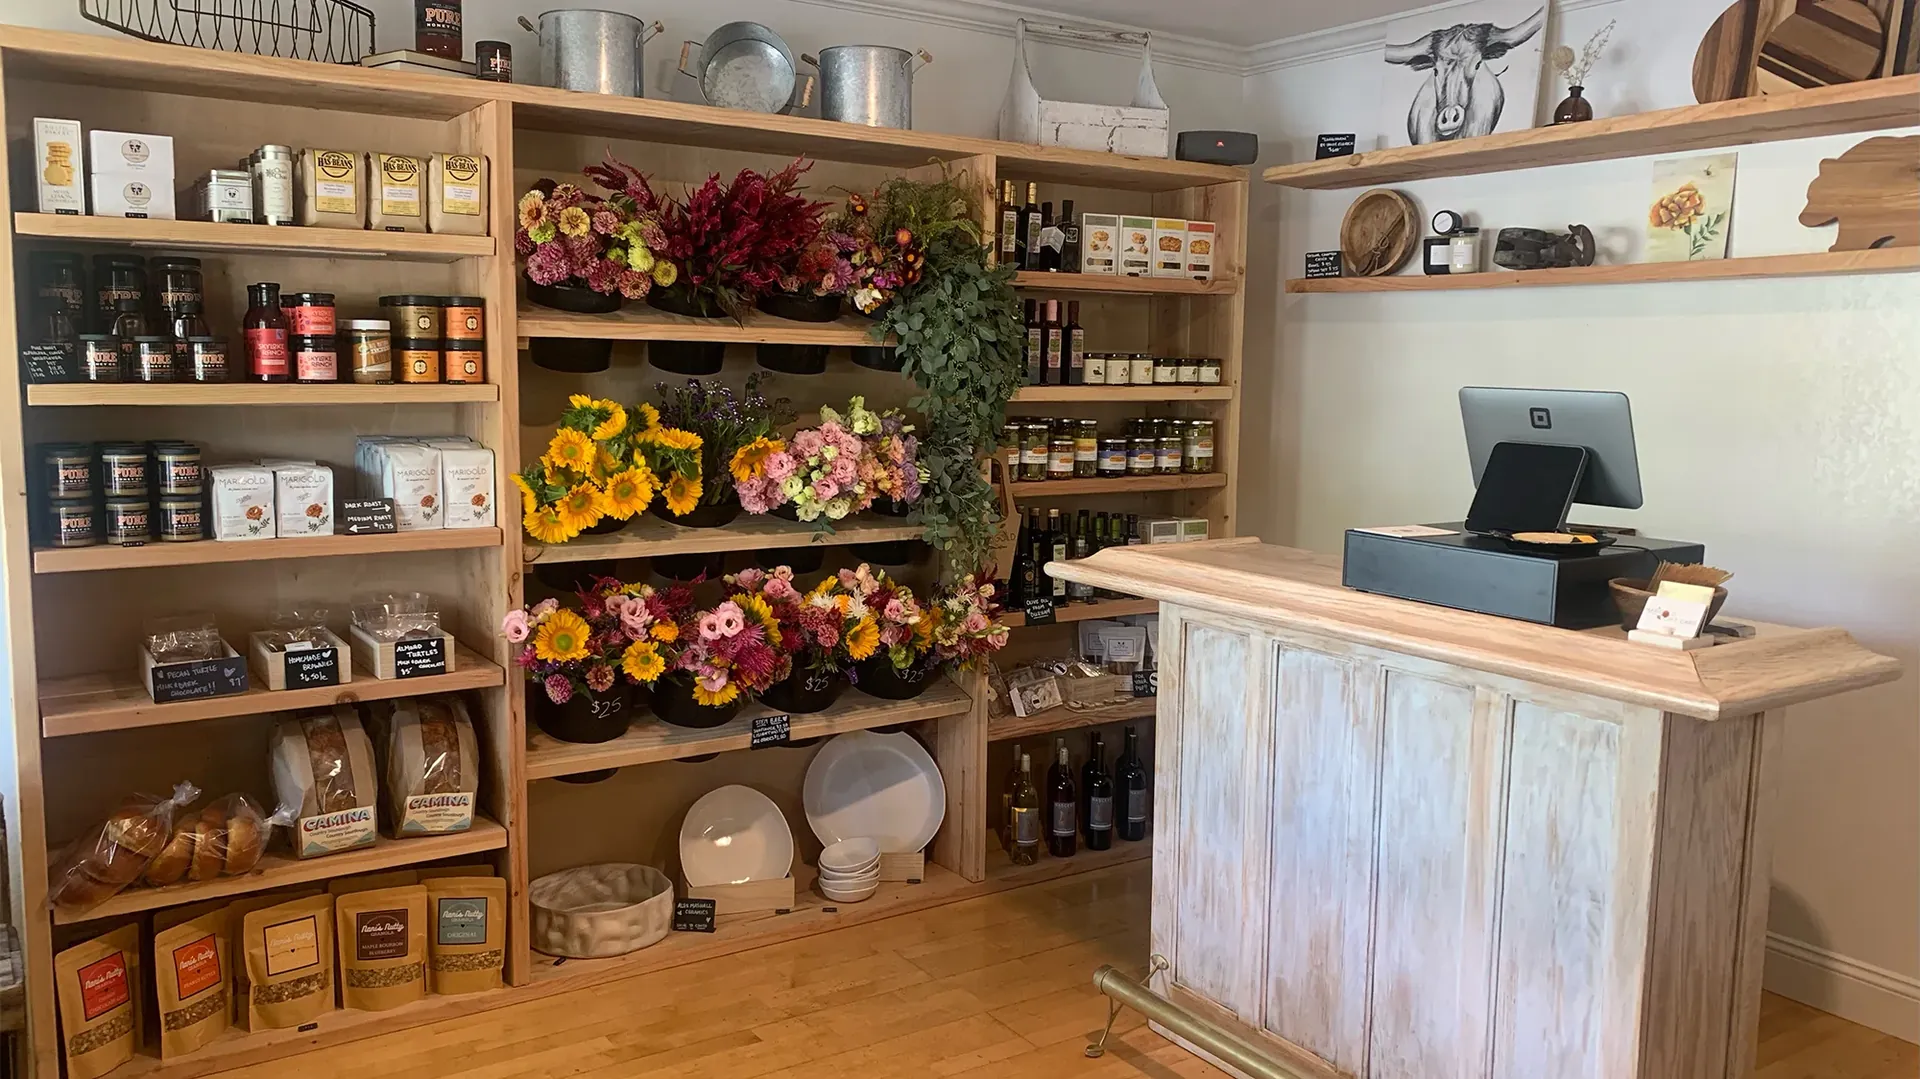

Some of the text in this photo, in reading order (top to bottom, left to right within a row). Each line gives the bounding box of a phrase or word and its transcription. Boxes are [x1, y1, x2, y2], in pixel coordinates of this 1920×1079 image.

[425, 7, 461, 26] PURE
[317, 156, 353, 170] HAS BEANS
[383, 161, 417, 173] HAS BEANS
[445, 160, 478, 173] HAS BEANS
[59, 469, 89, 480] PURE
[113, 467, 144, 478] PURE
[170, 465, 199, 476] PURE
[397, 466, 436, 478] MARIGOLD
[448, 465, 487, 478] MARIGOLD
[281, 474, 325, 487] MARIGOLD
[61, 517, 92, 529] PURE
[118, 514, 148, 525] PURE
[172, 513, 200, 524] PURE
[396, 643, 423, 652] ALMOND
[406, 648, 439, 658] TURTLES
[288, 653, 321, 664] HOMEMADE
[302, 659, 334, 671] BROWNIES
[166, 665, 218, 679] PECAN TURTLE
[901, 668, 925, 683] $25
[156, 682, 174, 691] MILK
[178, 680, 198, 689] DARK
[804, 676, 829, 692] $25
[591, 696, 622, 719] $25
[408, 795, 469, 810] CAMINA
[303, 809, 371, 832] CAMINA
[464, 910, 484, 920] Nutty
[384, 922, 405, 933] Nutty
[379, 941, 404, 949] BOURBON
[105, 967, 124, 980] Nutty
